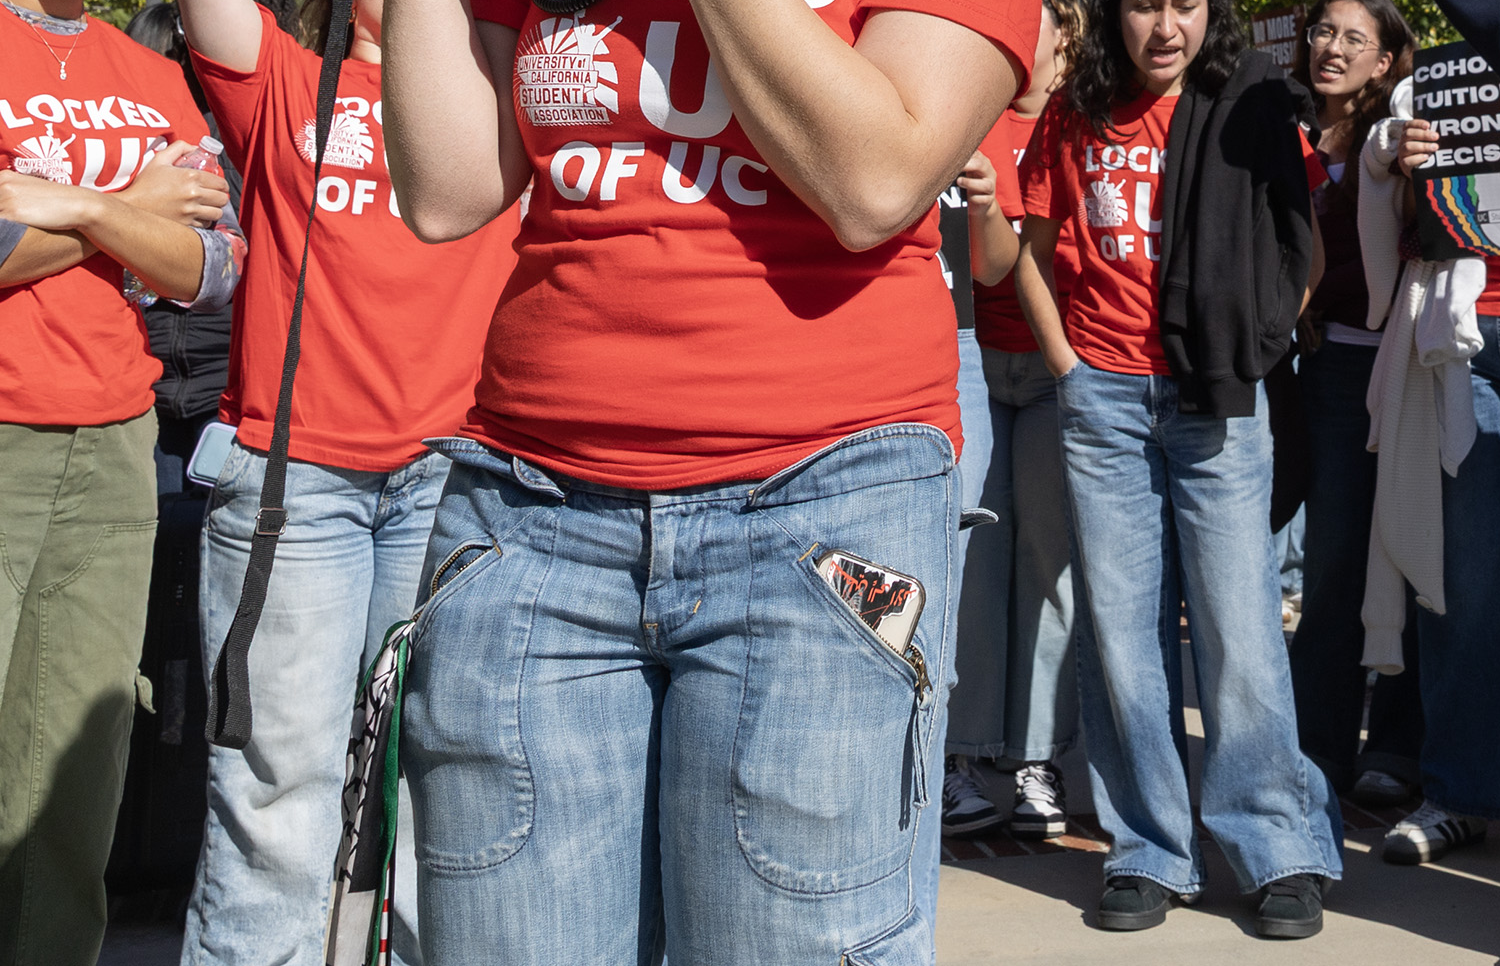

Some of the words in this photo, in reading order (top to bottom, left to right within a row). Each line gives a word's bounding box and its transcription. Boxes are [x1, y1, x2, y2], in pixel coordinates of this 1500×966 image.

[519, 56, 577, 71] UNIVERSITY
[531, 71, 591, 84] CALIFORNIA
[1414, 56, 1494, 83] COHO
[521, 87, 581, 105] STUDENT
[0, 94, 171, 130] LOCKED
[534, 108, 605, 122] ASSOCIATION
[551, 141, 645, 202] OF
[661, 141, 768, 206] UC
[1085, 145, 1167, 174] LOCK
[316, 175, 378, 215] OF
[1100, 234, 1135, 263] OF
